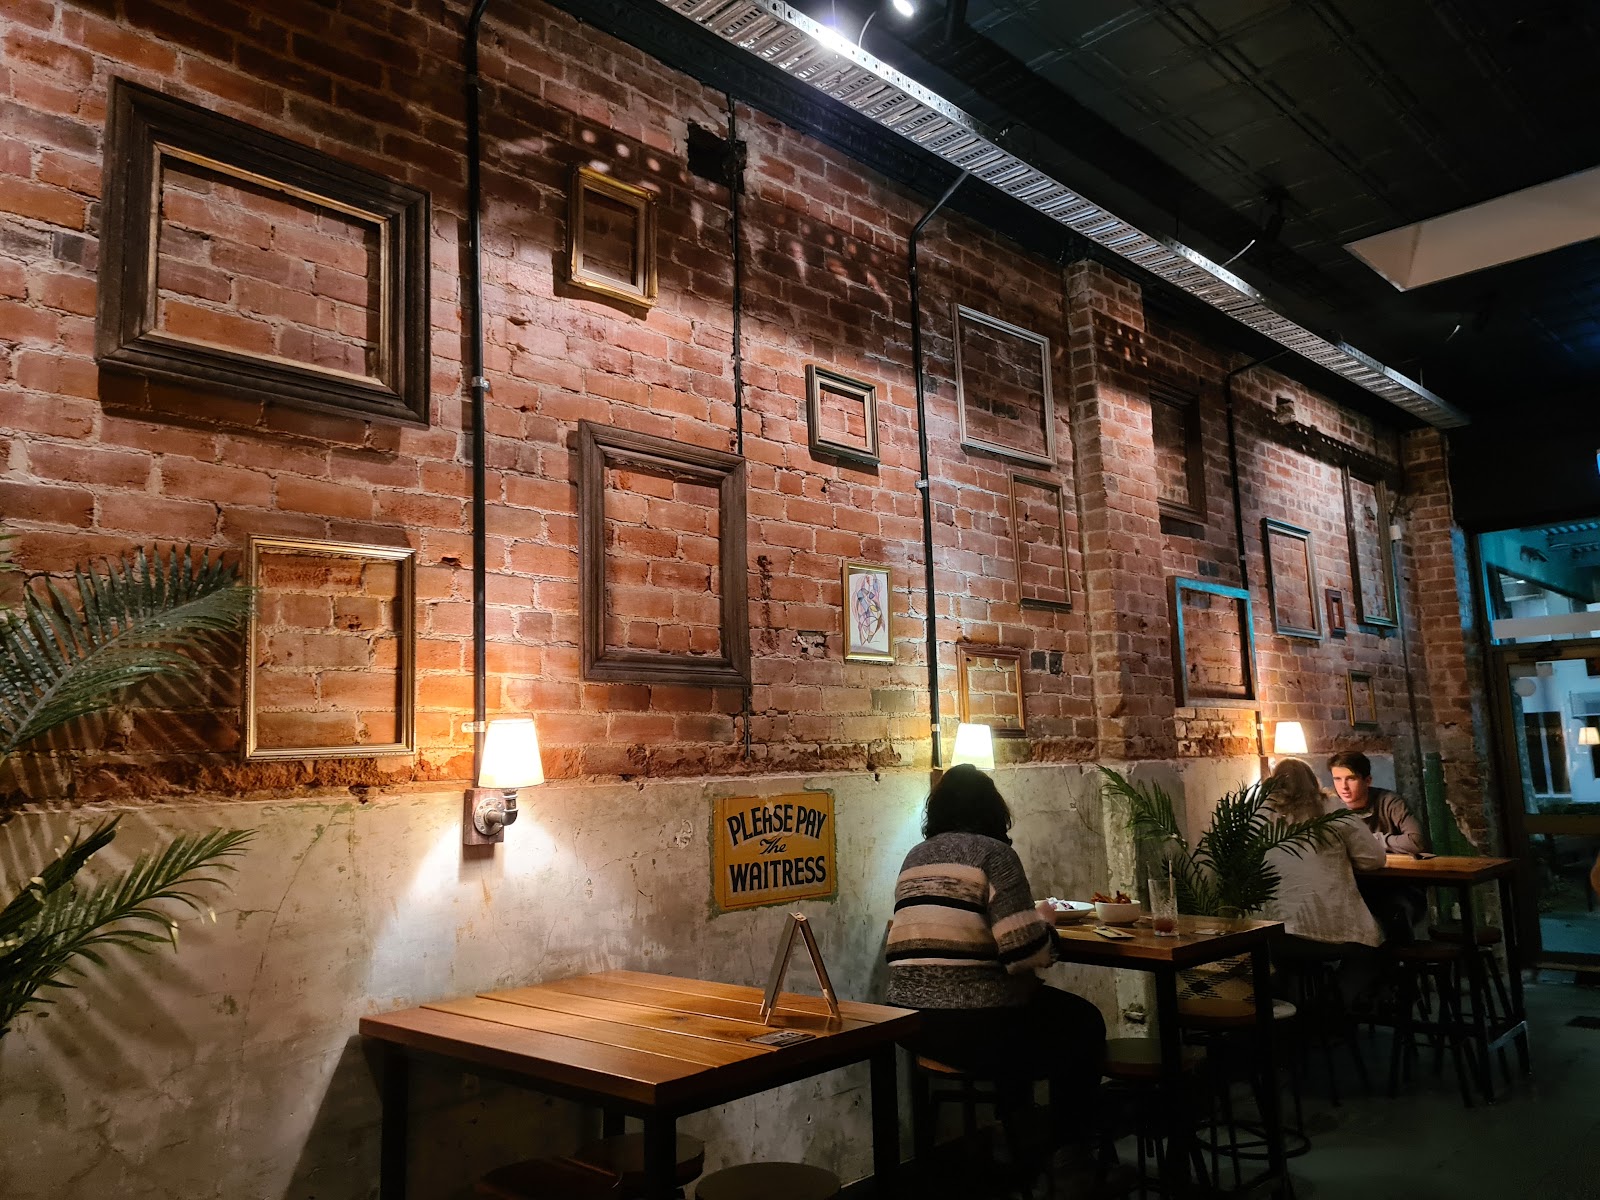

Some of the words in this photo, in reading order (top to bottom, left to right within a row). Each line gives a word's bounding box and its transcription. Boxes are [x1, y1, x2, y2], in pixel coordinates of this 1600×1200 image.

[727, 804, 793, 846] PLEASE
[795, 805, 827, 839] PAY
[760, 837, 786, 854] The
[729, 856, 826, 892] WAITRESS
